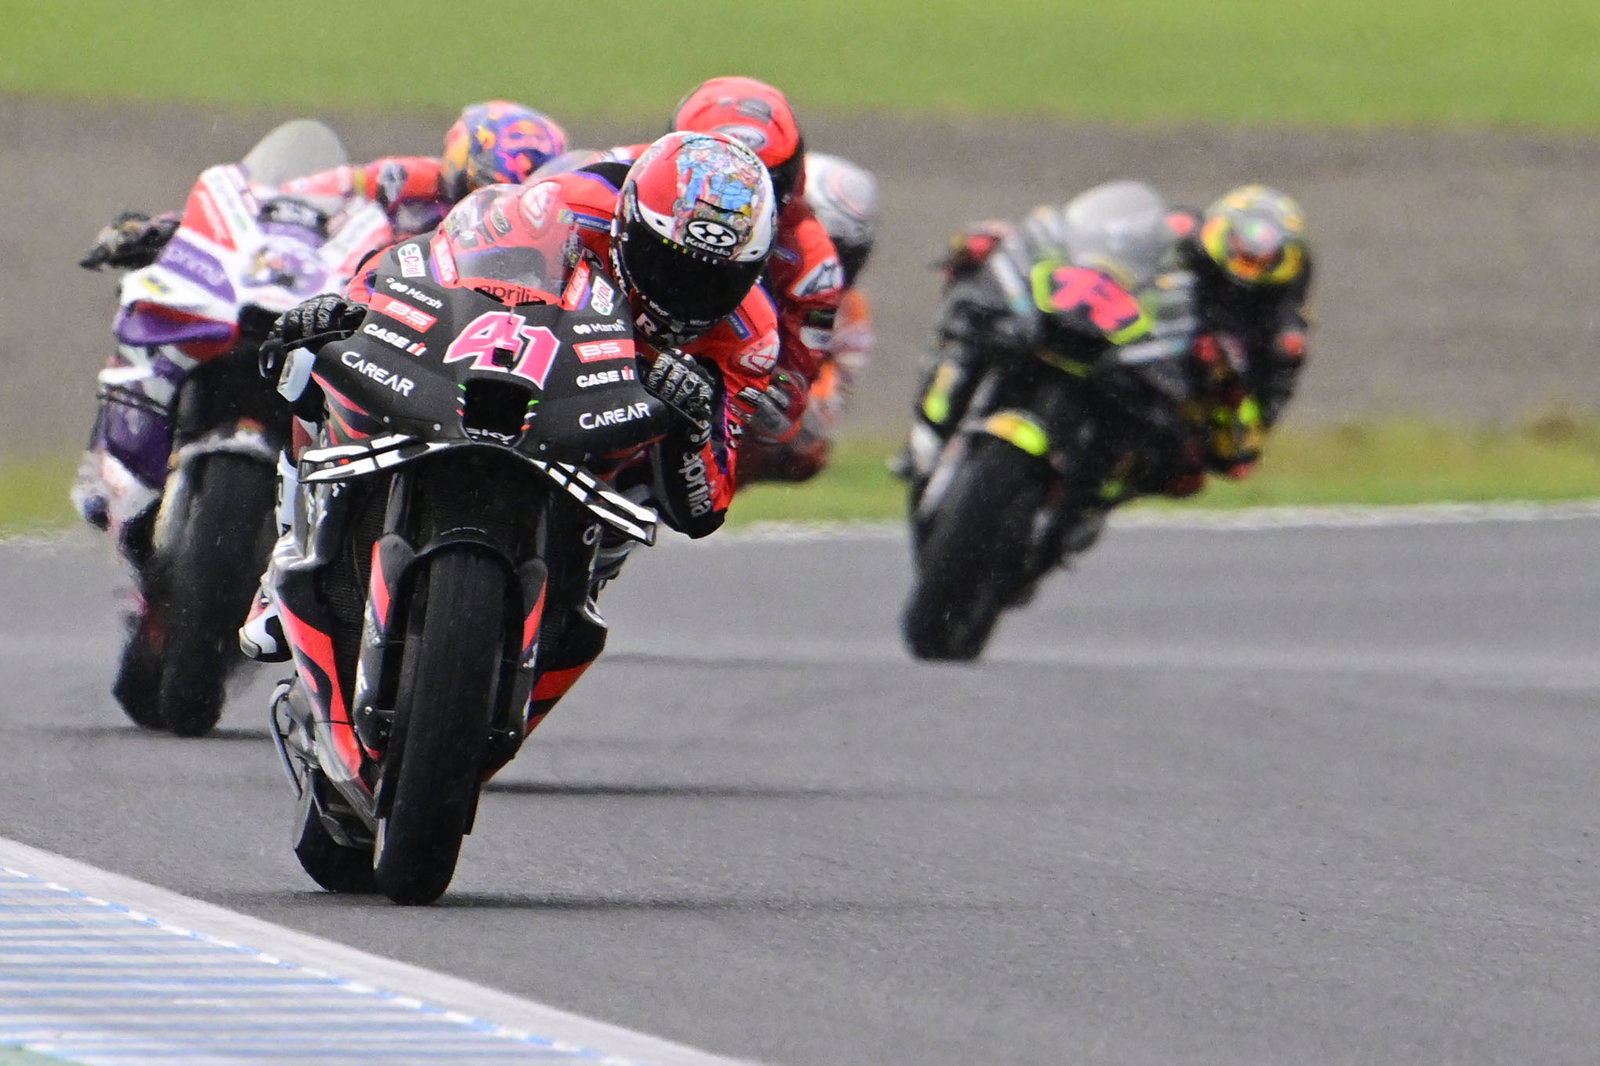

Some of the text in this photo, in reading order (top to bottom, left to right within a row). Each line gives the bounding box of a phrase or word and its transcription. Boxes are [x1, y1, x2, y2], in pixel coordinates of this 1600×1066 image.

[405, 287, 443, 309] Marsh
[384, 300, 433, 327] BS
[363, 323, 410, 349] CASE
[589, 322, 626, 333] Marsh
[443, 311, 561, 391] 41
[578, 342, 622, 357] BS
[576, 370, 620, 388] CASE
[678, 450, 712, 518] aprilia
